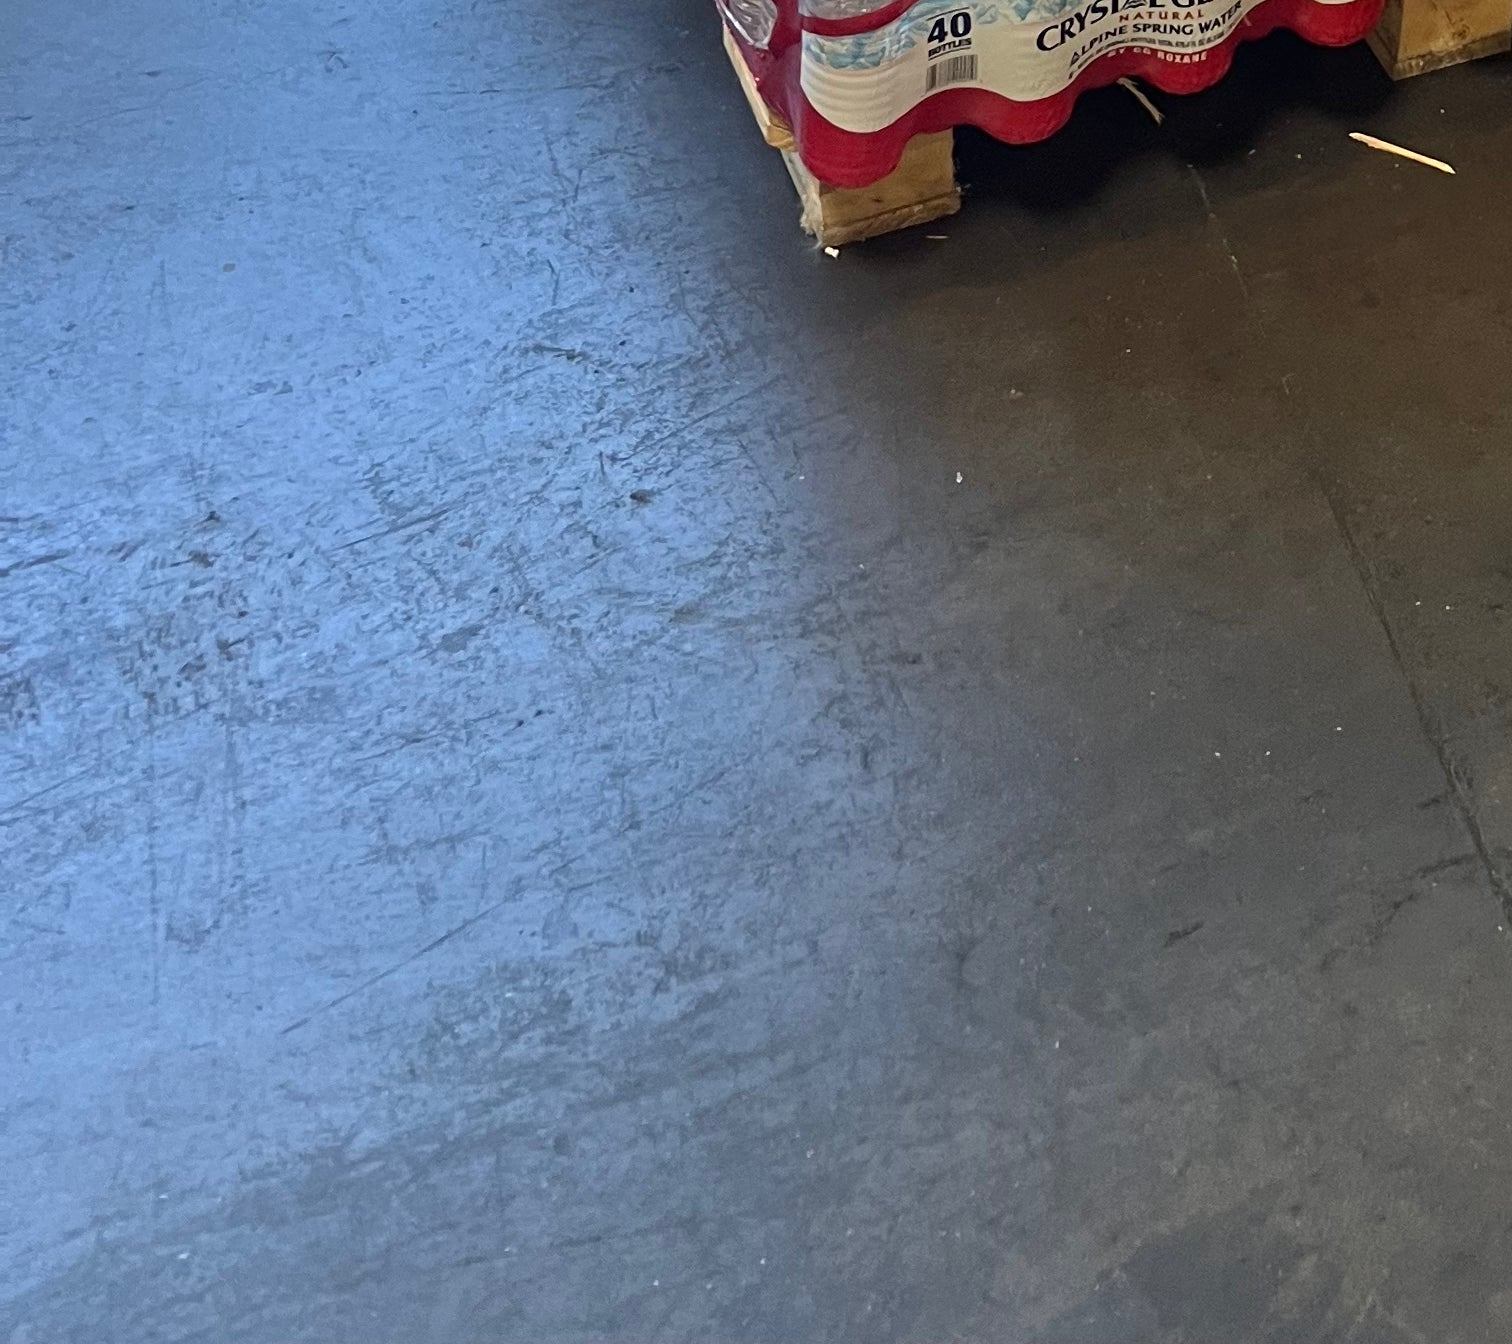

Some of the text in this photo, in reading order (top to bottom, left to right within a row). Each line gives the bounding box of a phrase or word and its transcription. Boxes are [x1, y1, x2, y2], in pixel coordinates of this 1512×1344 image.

[1119, 9, 1204, 23] NATURAL
[928, 12, 972, 41] 40
[1071, 0, 1242, 65] ALPINE SPRING WATER
[928, 38, 972, 57] BOTTLES
[1157, 50, 1207, 63] ROXANE
